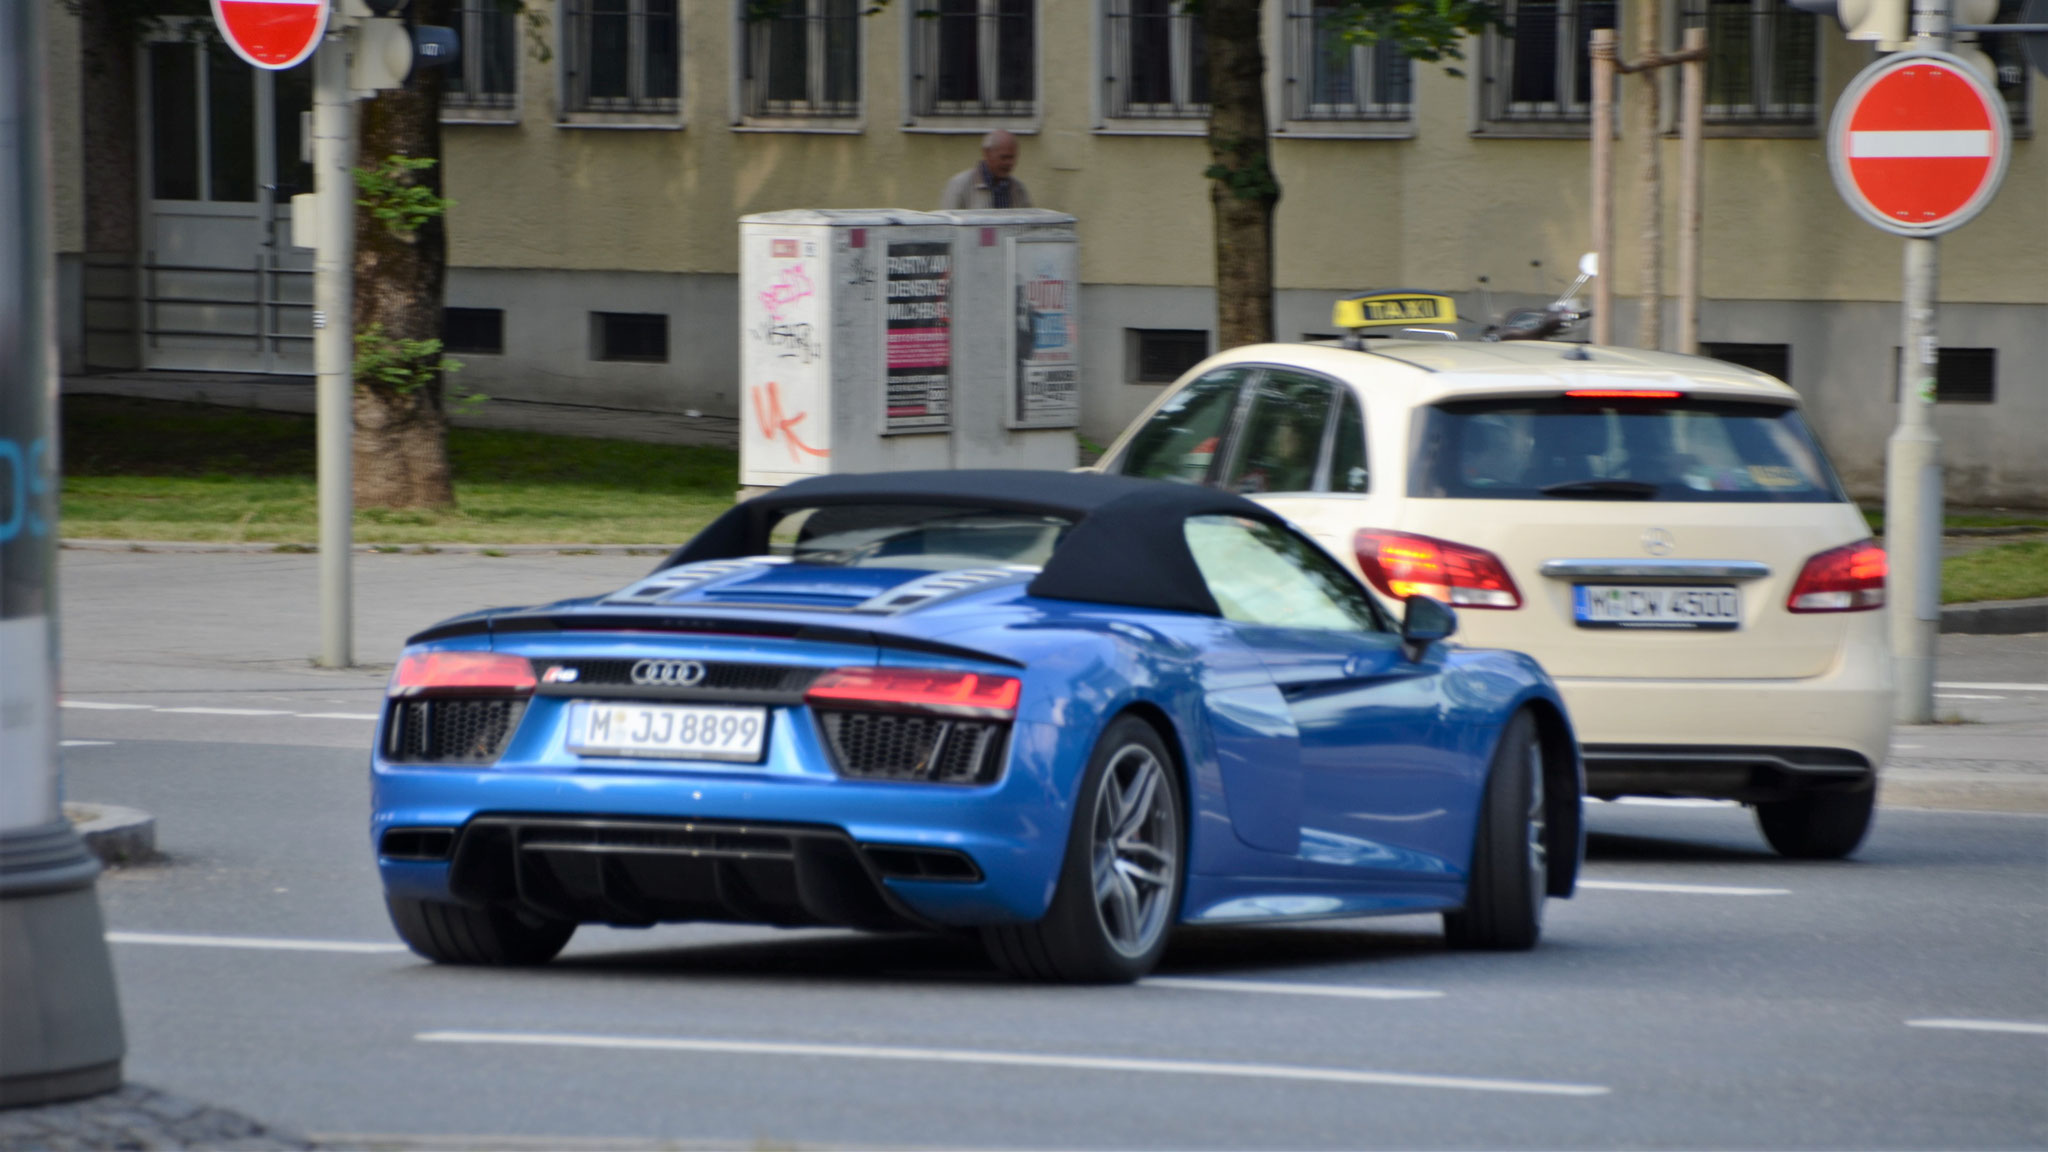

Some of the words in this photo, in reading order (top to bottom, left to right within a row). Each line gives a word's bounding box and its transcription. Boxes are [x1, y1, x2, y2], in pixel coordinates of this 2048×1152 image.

[1365, 300, 1436, 320] TAXI
[589, 709, 612, 742] M
[631, 711, 676, 744] JJ
[680, 714, 759, 748] 8899
